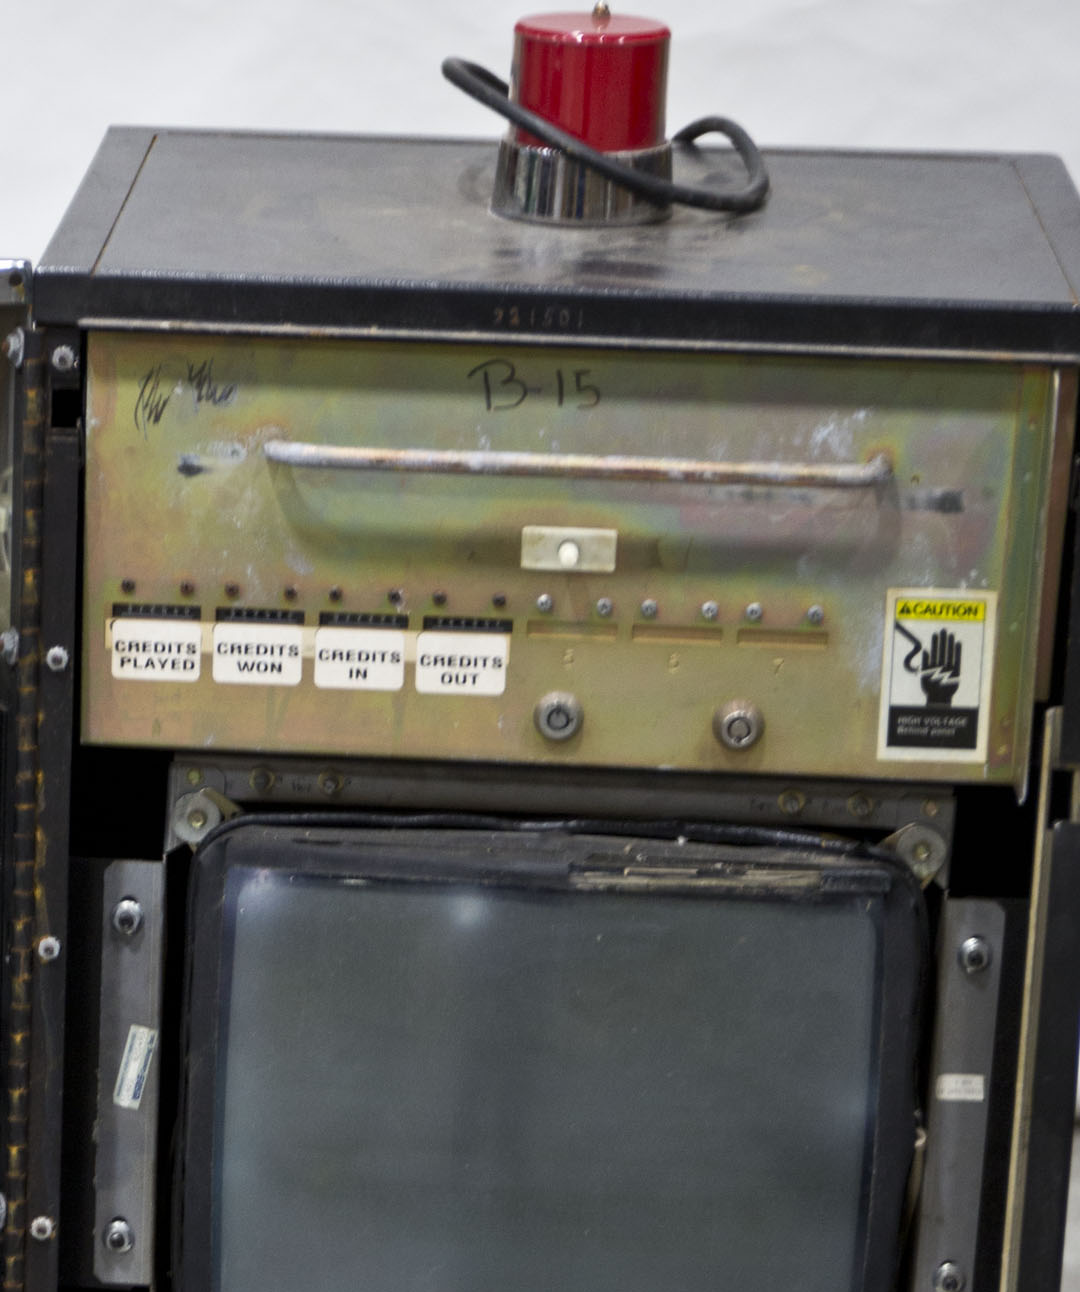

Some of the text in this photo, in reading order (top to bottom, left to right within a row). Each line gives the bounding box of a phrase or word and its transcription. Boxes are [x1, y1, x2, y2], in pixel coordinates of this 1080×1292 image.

[466, 358, 601, 411] B-15
[913, 602, 978, 617] CAUTION
[114, 640, 197, 655] CREDITS
[217, 642, 300, 658] CREDITS
[319, 648, 401, 664] CREDITS
[420, 654, 503, 670] CREDITS
[119, 657, 196, 672] PLAYED
[237, 660, 283, 674] WON
[348, 667, 368, 680] IN
[440, 671, 480, 686] OUT
[924, 716, 968, 726] VOLTAGE
